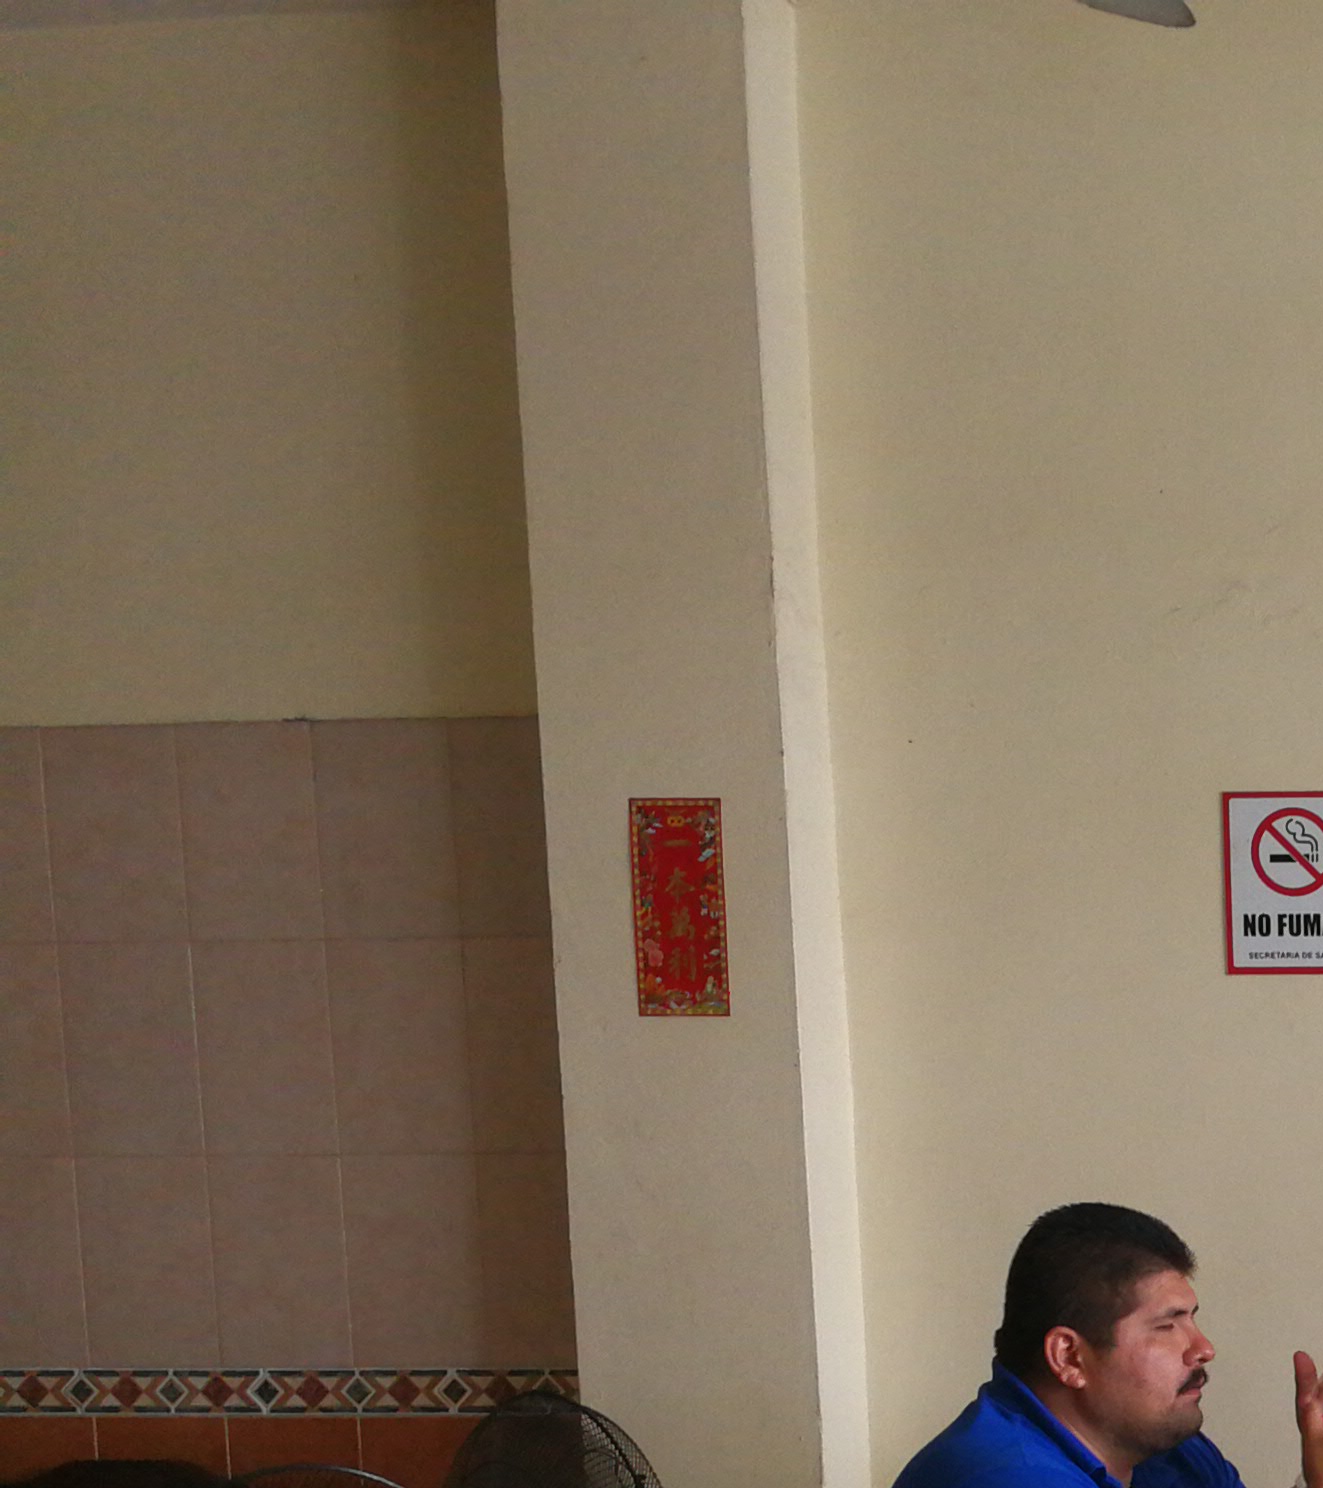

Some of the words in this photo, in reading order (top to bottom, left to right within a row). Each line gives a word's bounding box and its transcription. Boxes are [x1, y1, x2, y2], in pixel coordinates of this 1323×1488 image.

[1243, 913, 1271, 938] NO
[1248, 951, 1300, 960] SECRETARIA
[1301, 951, 1313, 960] DE
